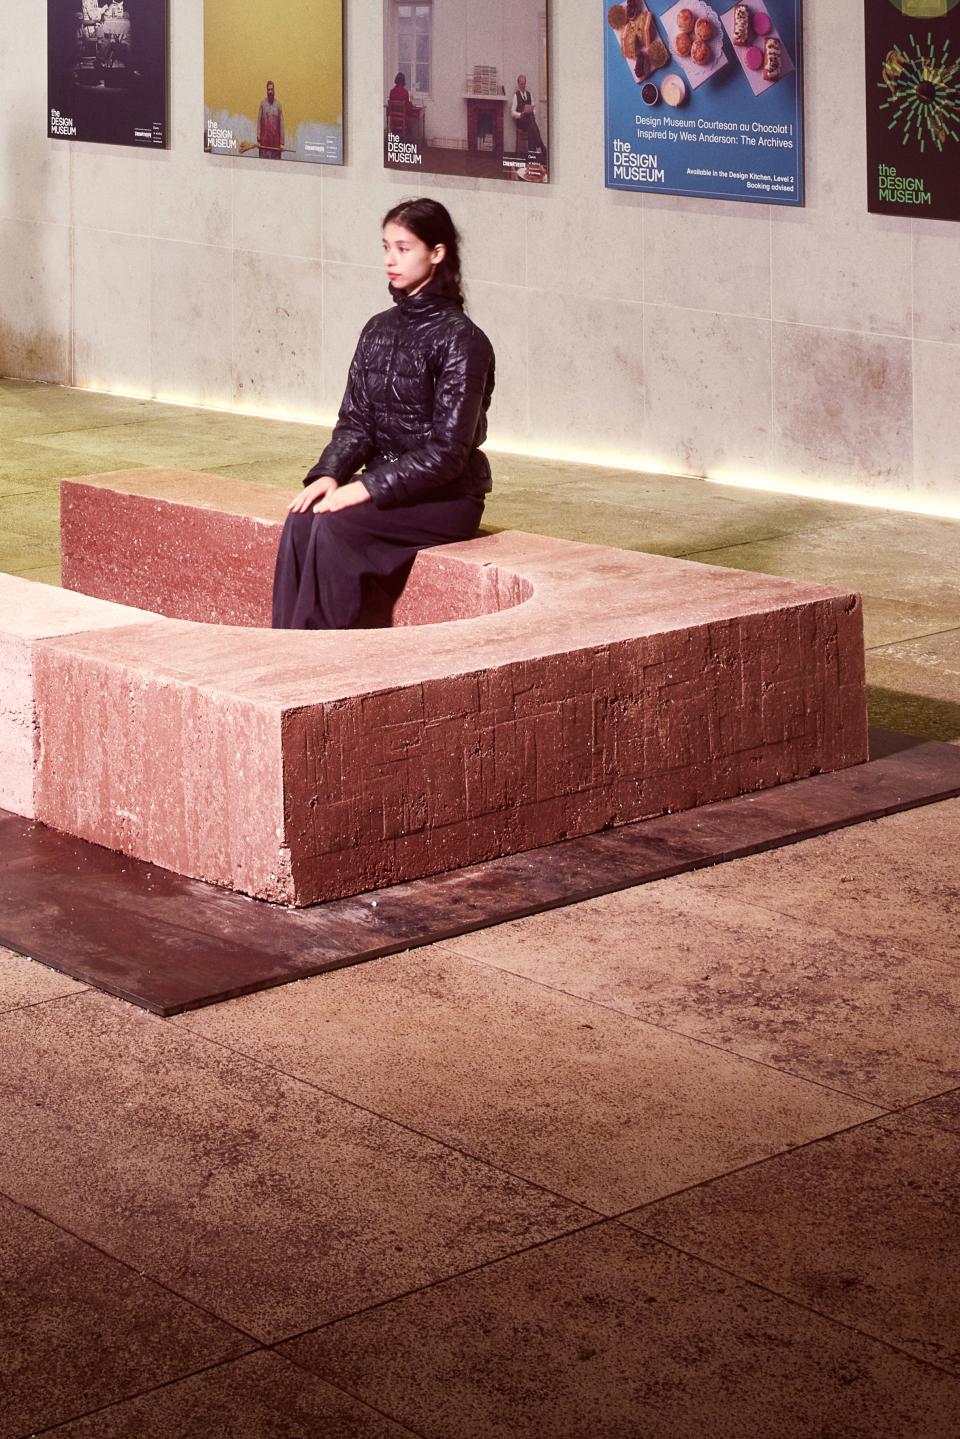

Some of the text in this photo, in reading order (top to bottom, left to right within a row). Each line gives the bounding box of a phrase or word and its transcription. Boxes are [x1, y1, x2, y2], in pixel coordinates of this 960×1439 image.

[51, 108, 61, 117] the
[51, 117, 73, 127] DESIGN
[207, 120, 218, 129] the
[635, 115, 662, 127] Design
[663, 117, 696, 128] Museum
[697, 118, 738, 131] Courtesan
[740, 122, 750, 131] au
[751, 122, 788, 134] Chocolat
[51, 126, 77, 136] MUSEUM
[207, 128, 233, 139] DESIGN
[387, 132, 400, 142] the
[207, 138, 237, 149] MUSEUM
[637, 128, 793, 149] Inspired by Wes Anderson: The Archives
[387, 142, 417, 154] DESIGN
[613, 139, 631, 152] the
[387, 153, 422, 164] MUSEUM
[613, 153, 657, 168] DESIGN
[613, 167, 665, 183] MUSEUM
[687, 167, 711, 176] Available
[719, 169, 728, 177] the
[729, 171, 748, 180] Design
[749, 172, 772, 182] Kitchen,
[773, 175, 789, 183] Level
[878, 163, 897, 176] the
[746, 181, 794, 192] Booking advised
[879, 176, 924, 191] DESIGN
[879, 189, 932, 205] MUSEUM
